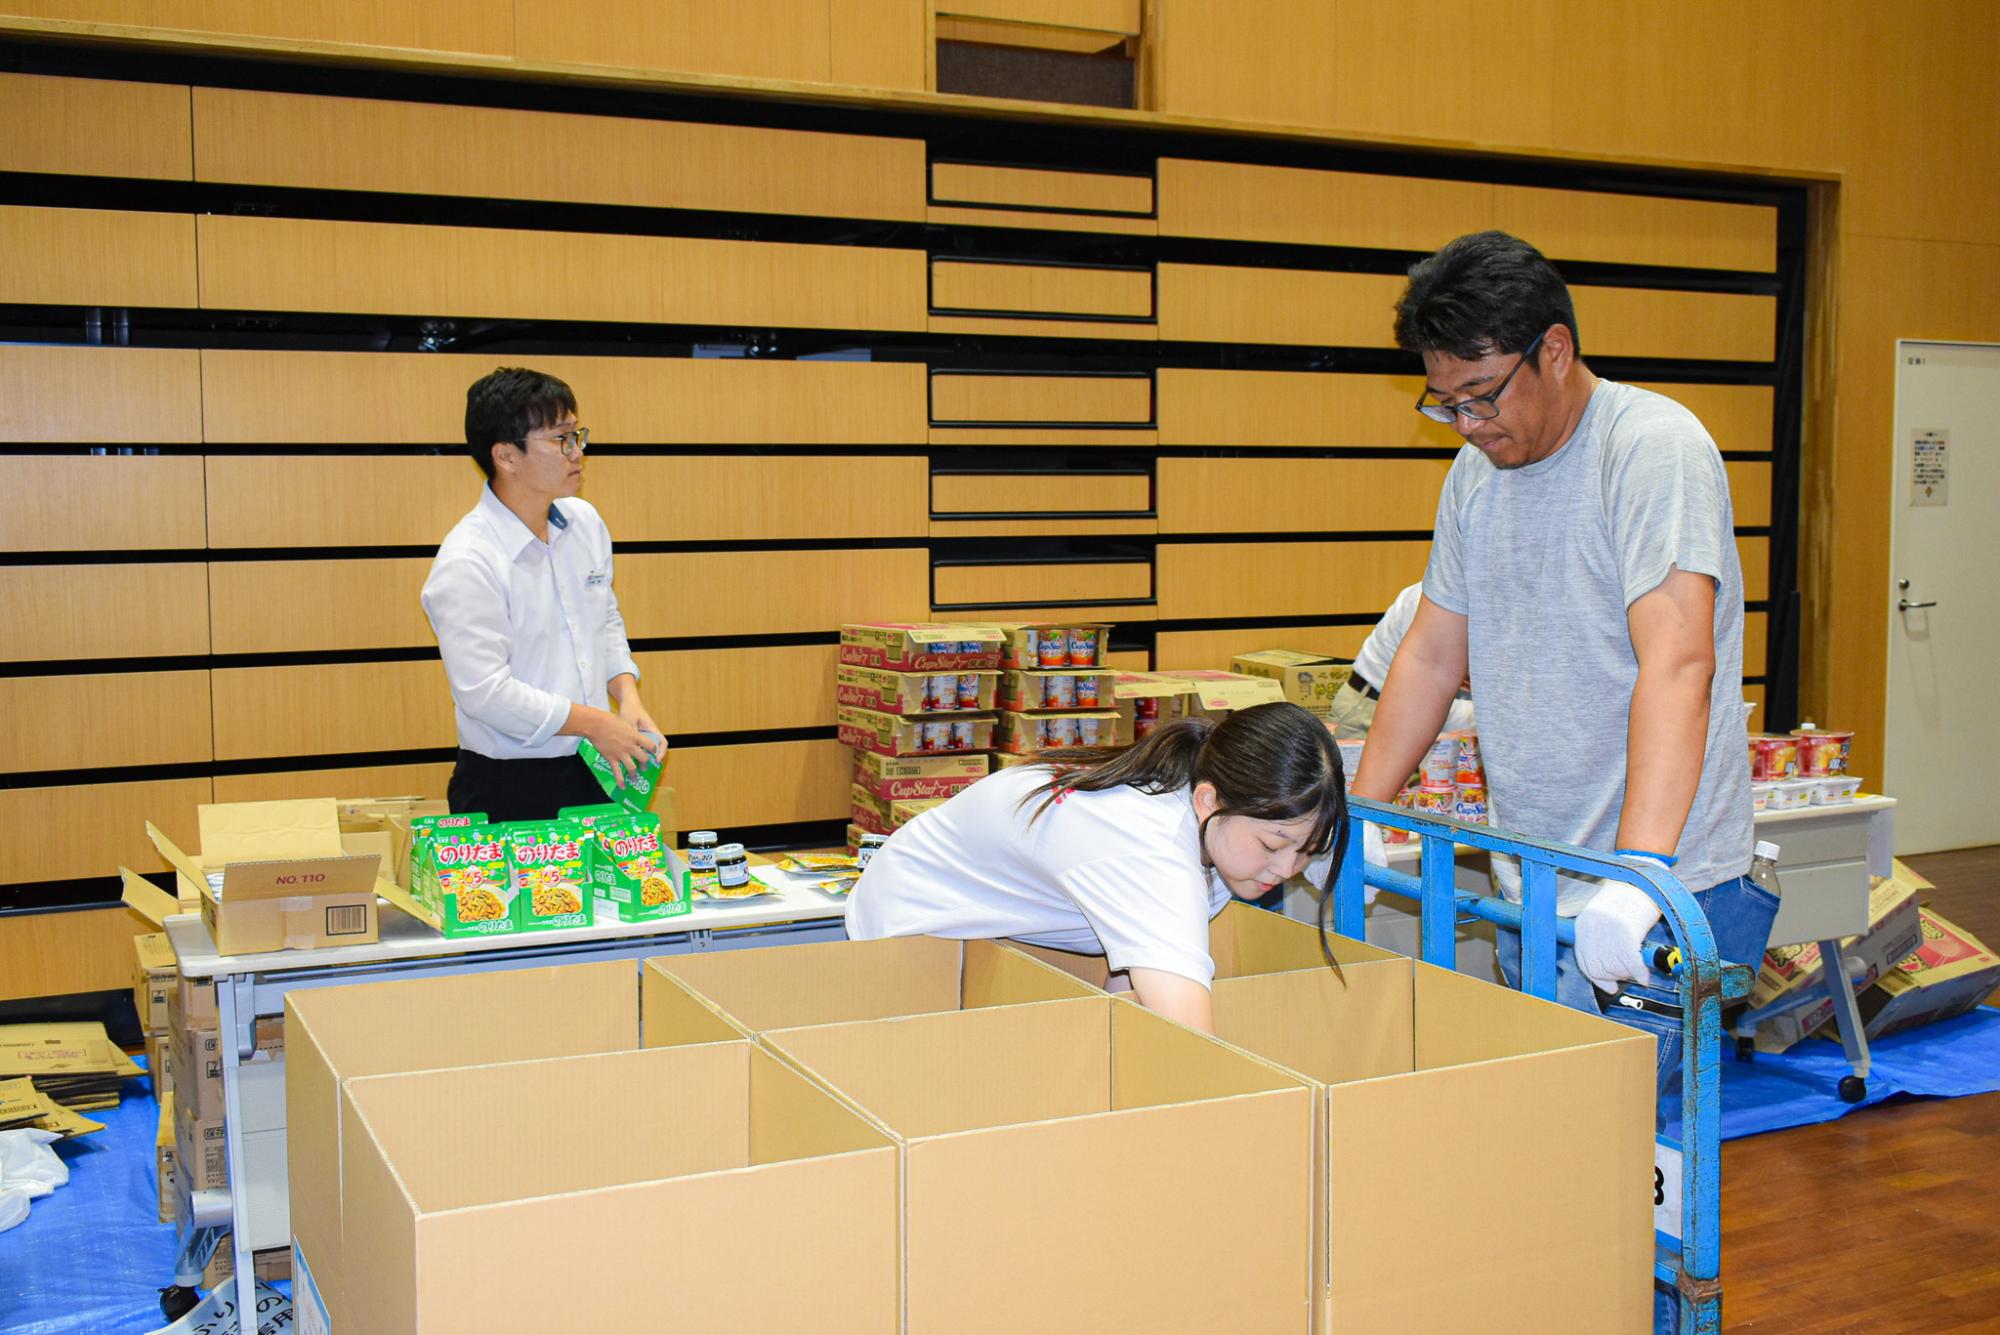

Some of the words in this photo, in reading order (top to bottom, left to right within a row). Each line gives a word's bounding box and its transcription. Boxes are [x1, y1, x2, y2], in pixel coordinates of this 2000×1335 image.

[890, 780, 938, 798] CupStar
[439, 841, 504, 865] のりたま
[516, 841, 581, 865] のりたま
[614, 832, 659, 858] のりたま
[275, 875, 299, 886] NO.
[302, 873, 326, 884] 110
[477, 919, 514, 933] のりたま
[552, 913, 587, 927] のりたま
